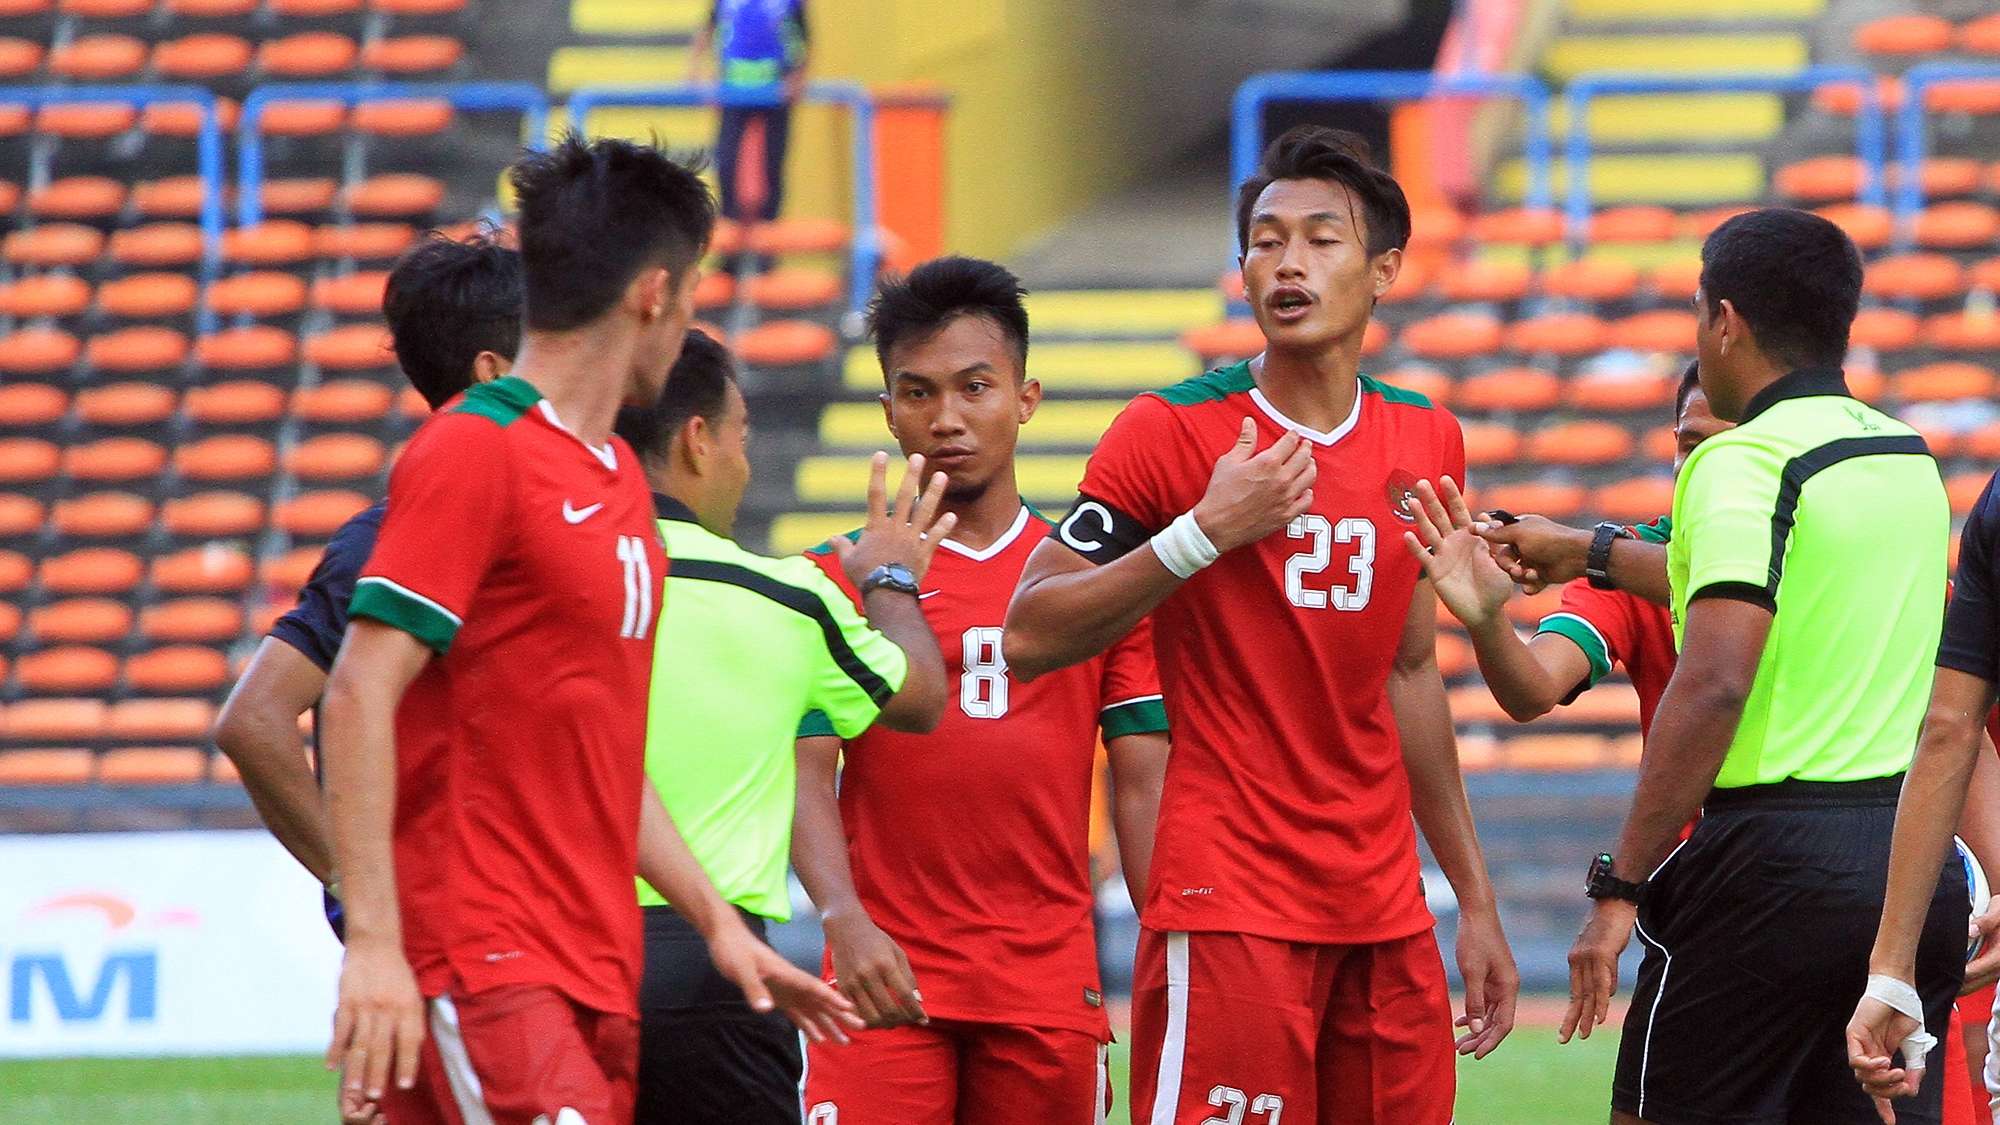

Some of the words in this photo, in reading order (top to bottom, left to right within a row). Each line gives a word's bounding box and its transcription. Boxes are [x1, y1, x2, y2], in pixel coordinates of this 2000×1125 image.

[1060, 501, 1113, 552] C
[1285, 514, 1376, 612] 23
[616, 534, 653, 640] 11
[960, 626, 1009, 719] 8
[9, 952, 156, 1022] M
